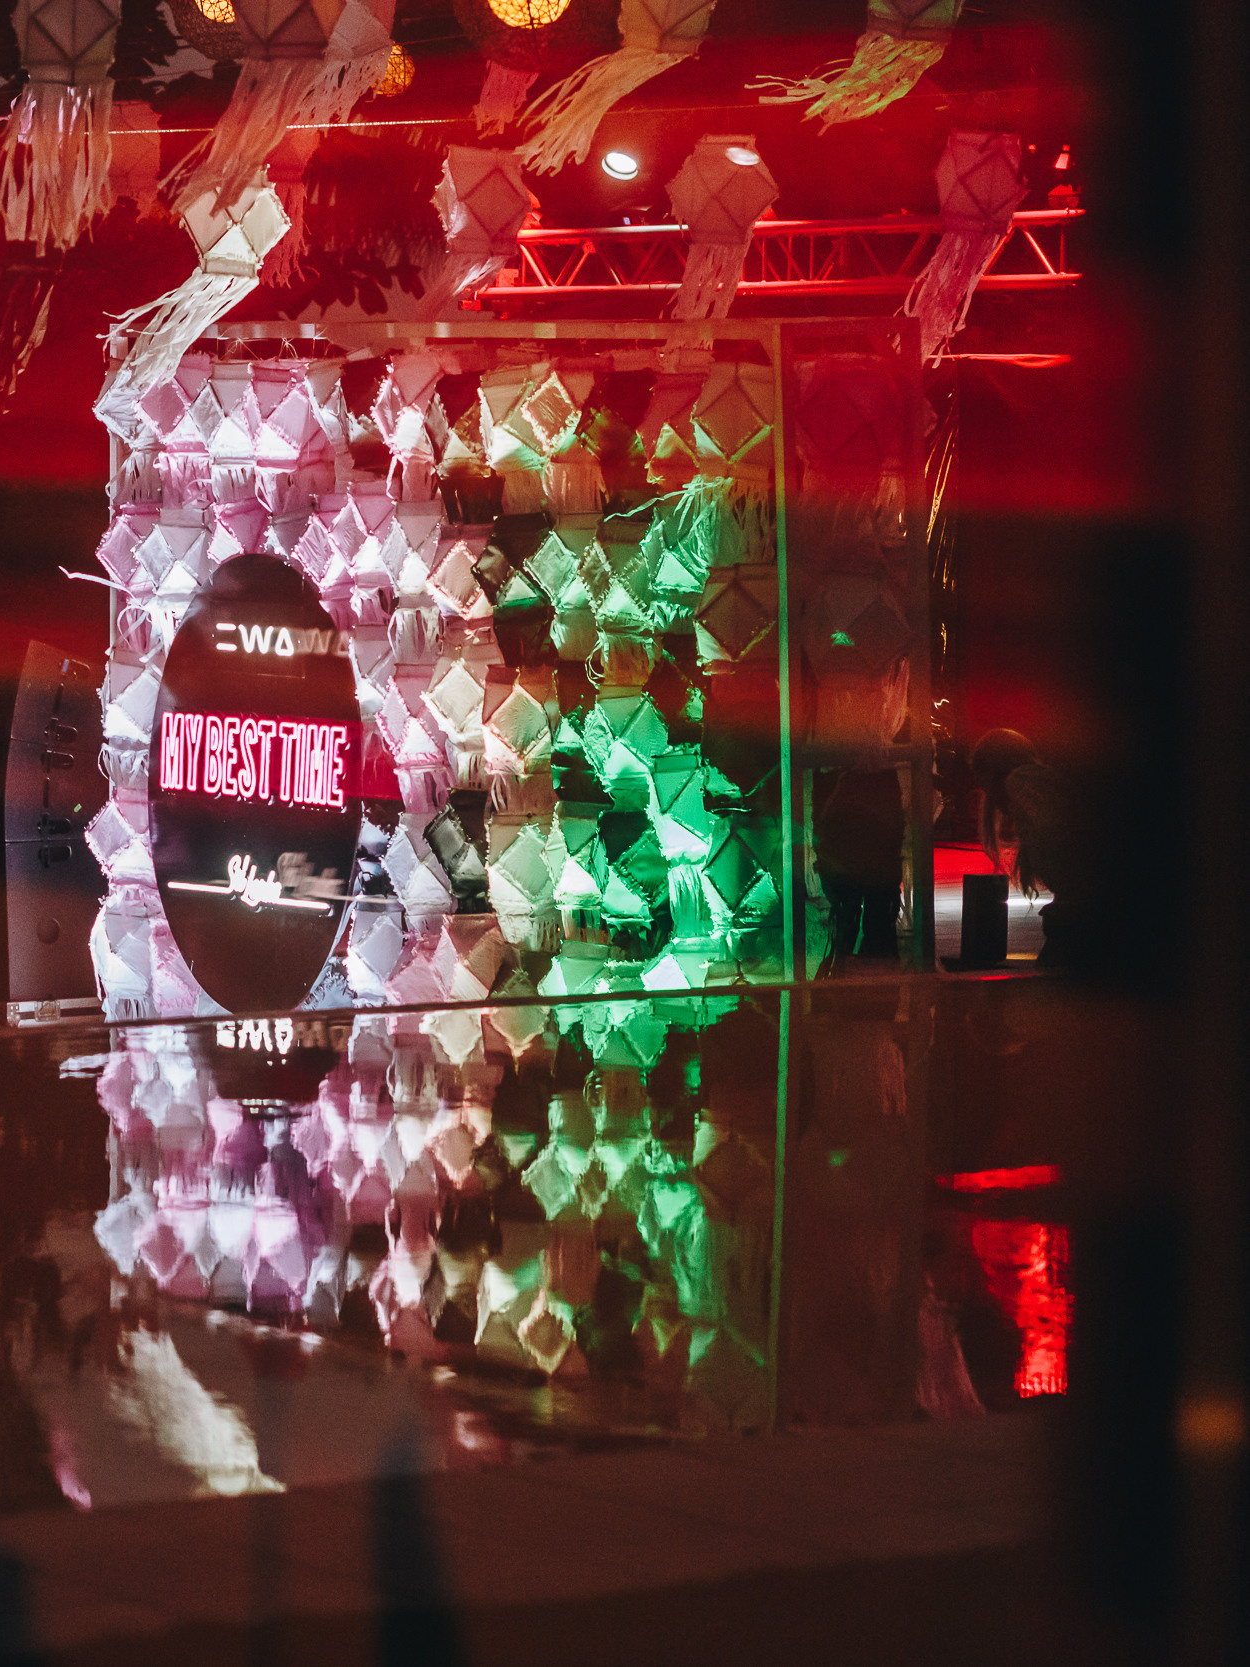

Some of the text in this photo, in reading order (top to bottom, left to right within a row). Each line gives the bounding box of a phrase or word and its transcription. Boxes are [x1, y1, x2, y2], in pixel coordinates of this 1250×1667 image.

[160, 711, 347, 807] MY BEST TIME
